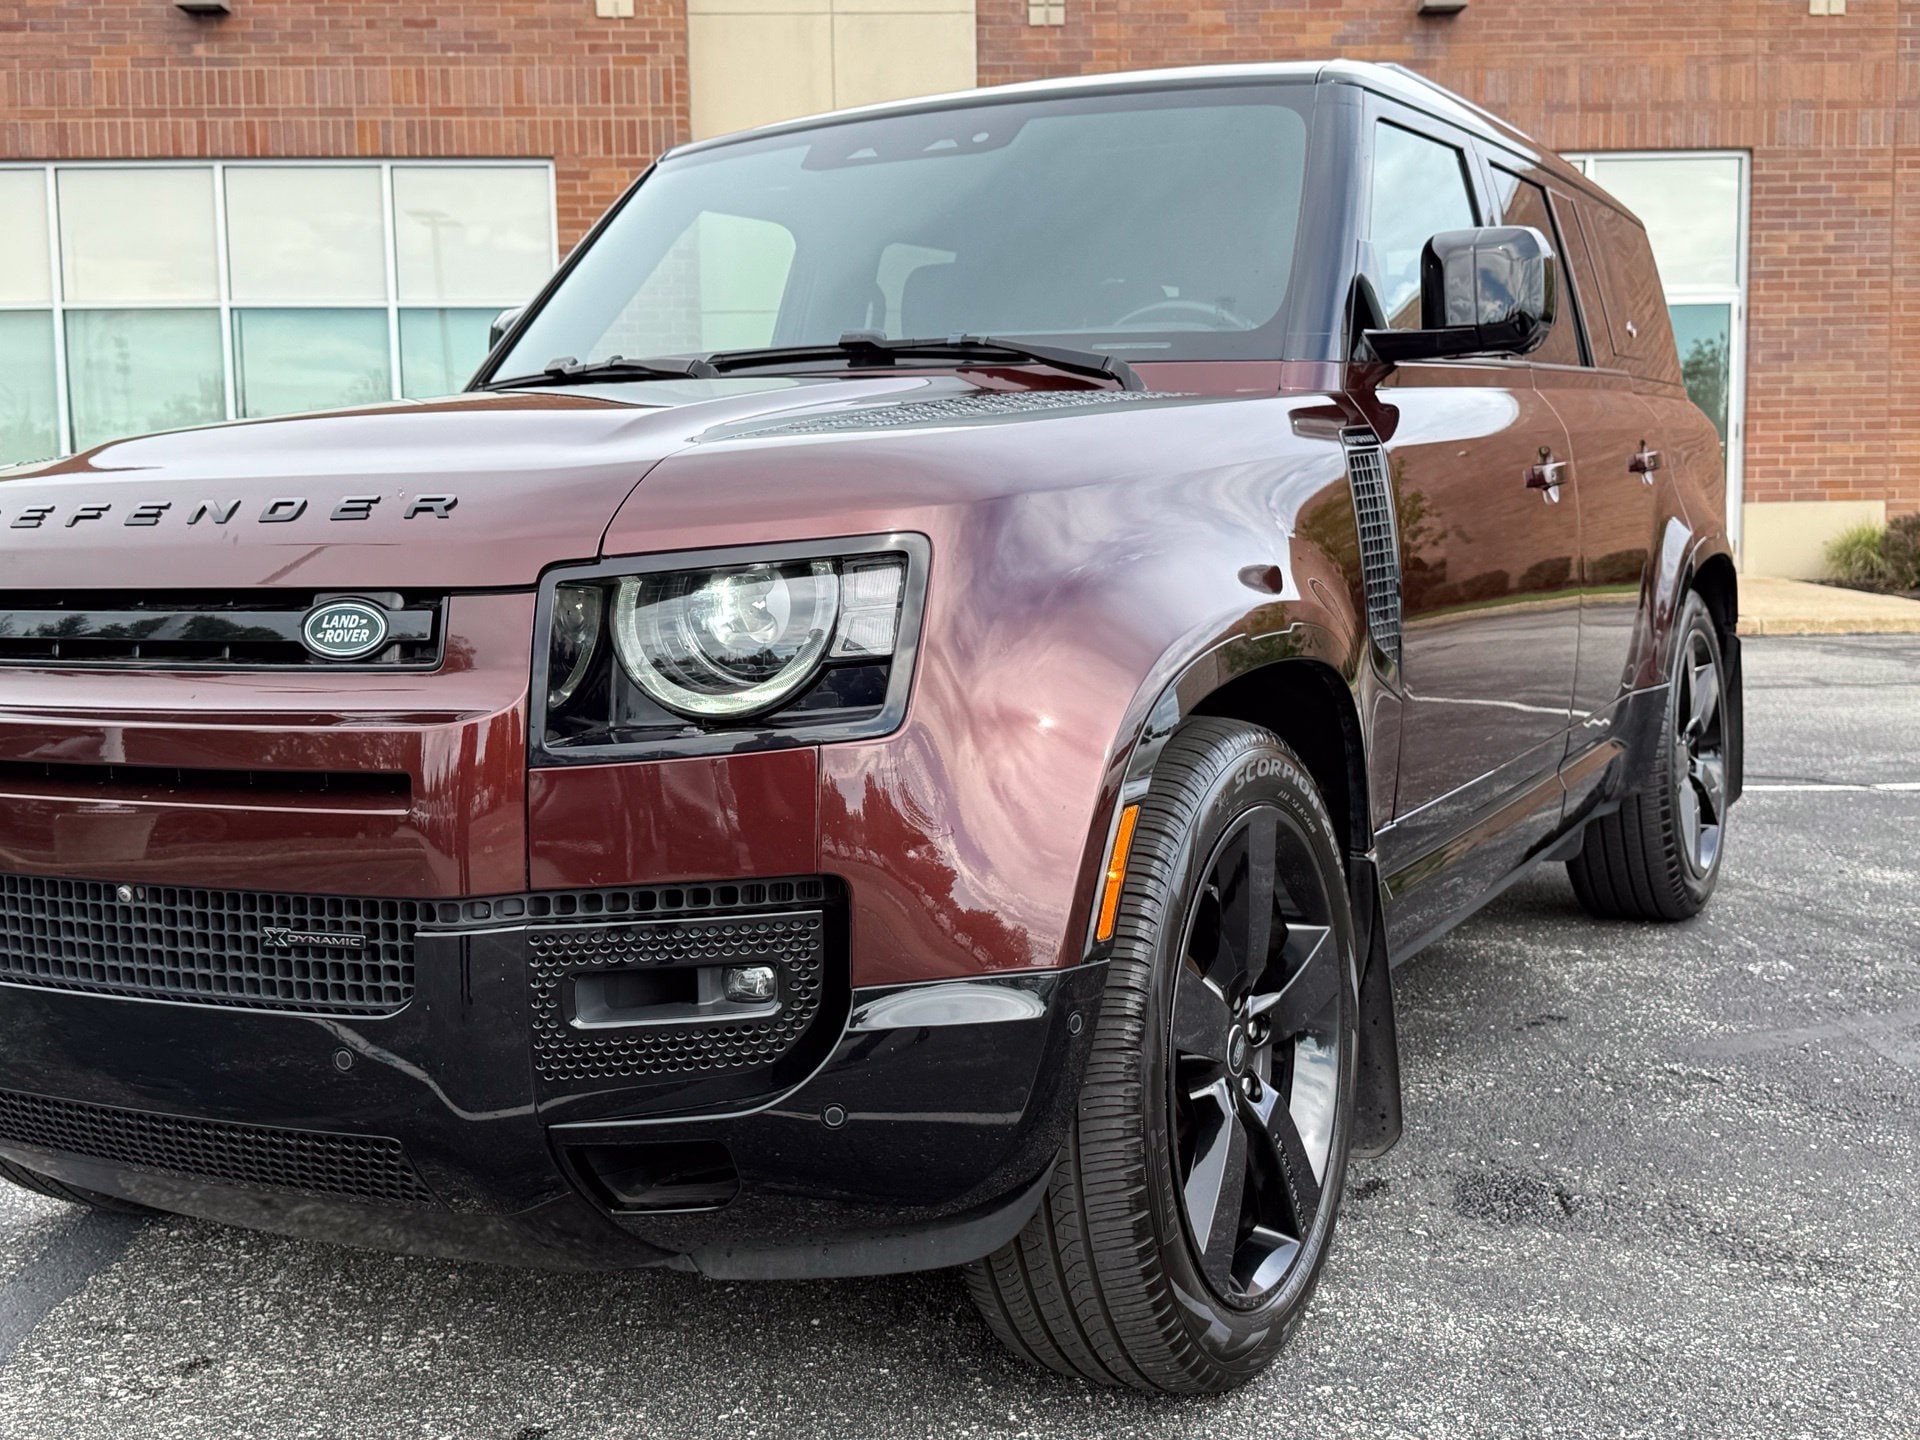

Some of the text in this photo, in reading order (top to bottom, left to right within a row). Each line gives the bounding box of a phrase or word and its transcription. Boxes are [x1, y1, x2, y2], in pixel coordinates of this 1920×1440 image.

[0, 493, 458, 528] EFENDER
[321, 614, 360, 629] LAND
[323, 629, 370, 643] ROVER
[1234, 757, 1320, 810] SCORPION
